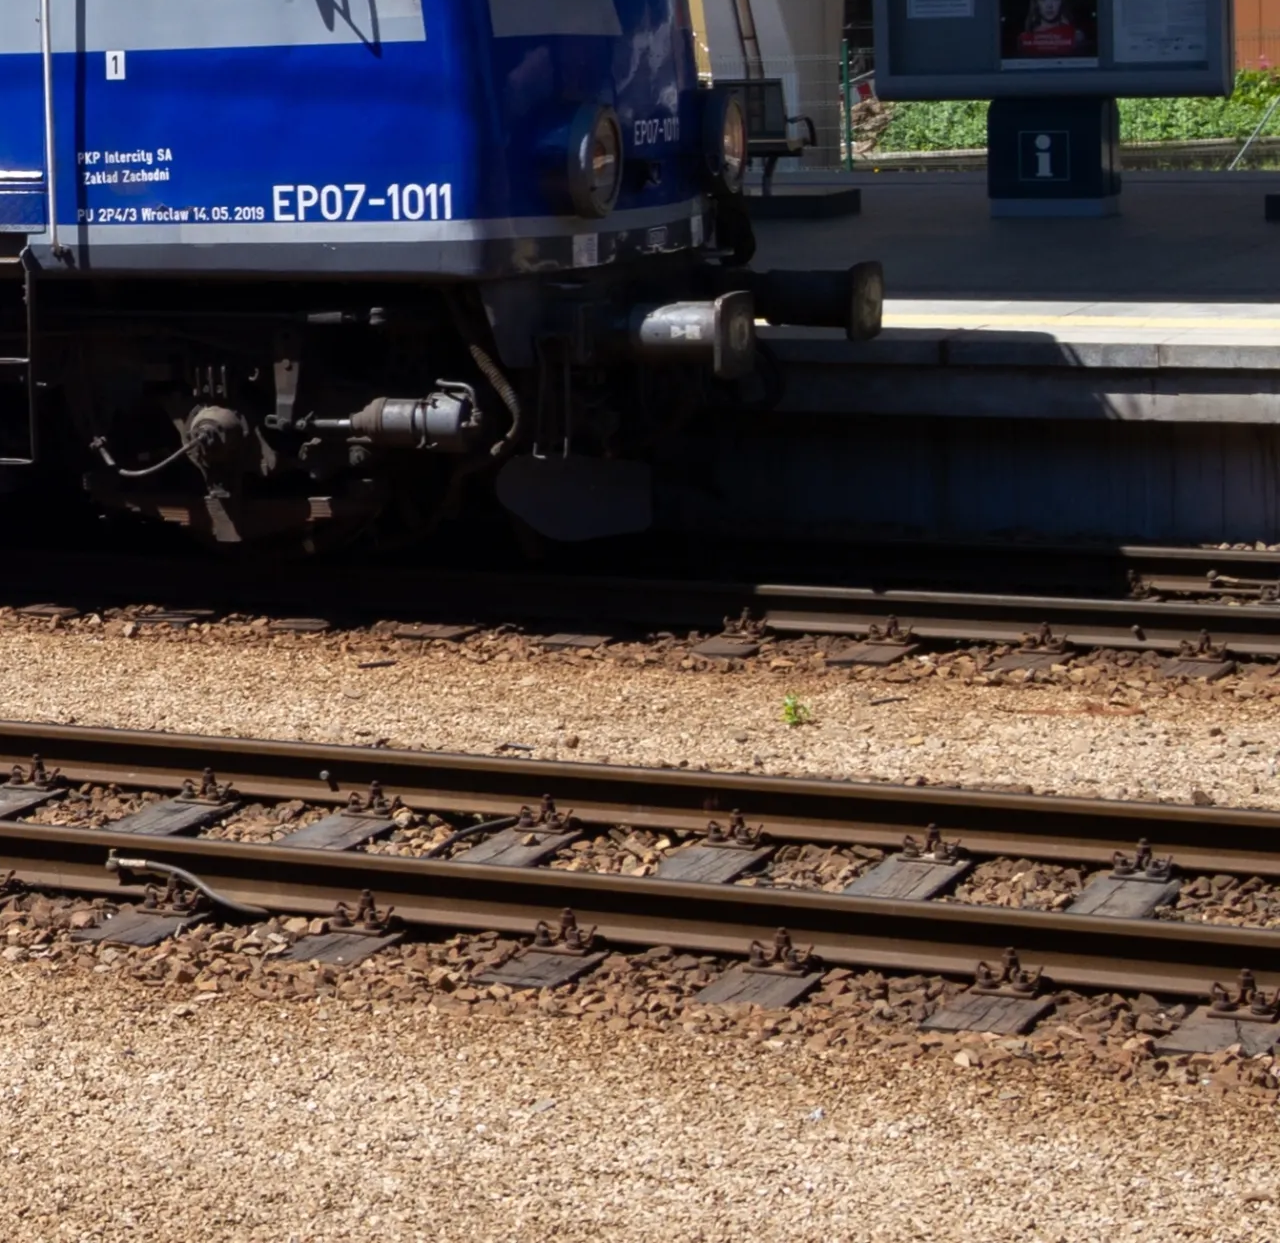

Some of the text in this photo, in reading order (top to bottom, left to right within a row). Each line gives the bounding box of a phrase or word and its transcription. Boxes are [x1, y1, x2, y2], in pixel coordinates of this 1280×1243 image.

[112, 55, 118, 75] 1
[77, 147, 173, 165] PKP Intercity SA
[122, 167, 170, 183] Zachodni
[272, 183, 453, 221] EP07-1011
[77, 208, 94, 222] PU
[98, 207, 137, 222] 2P4/3
